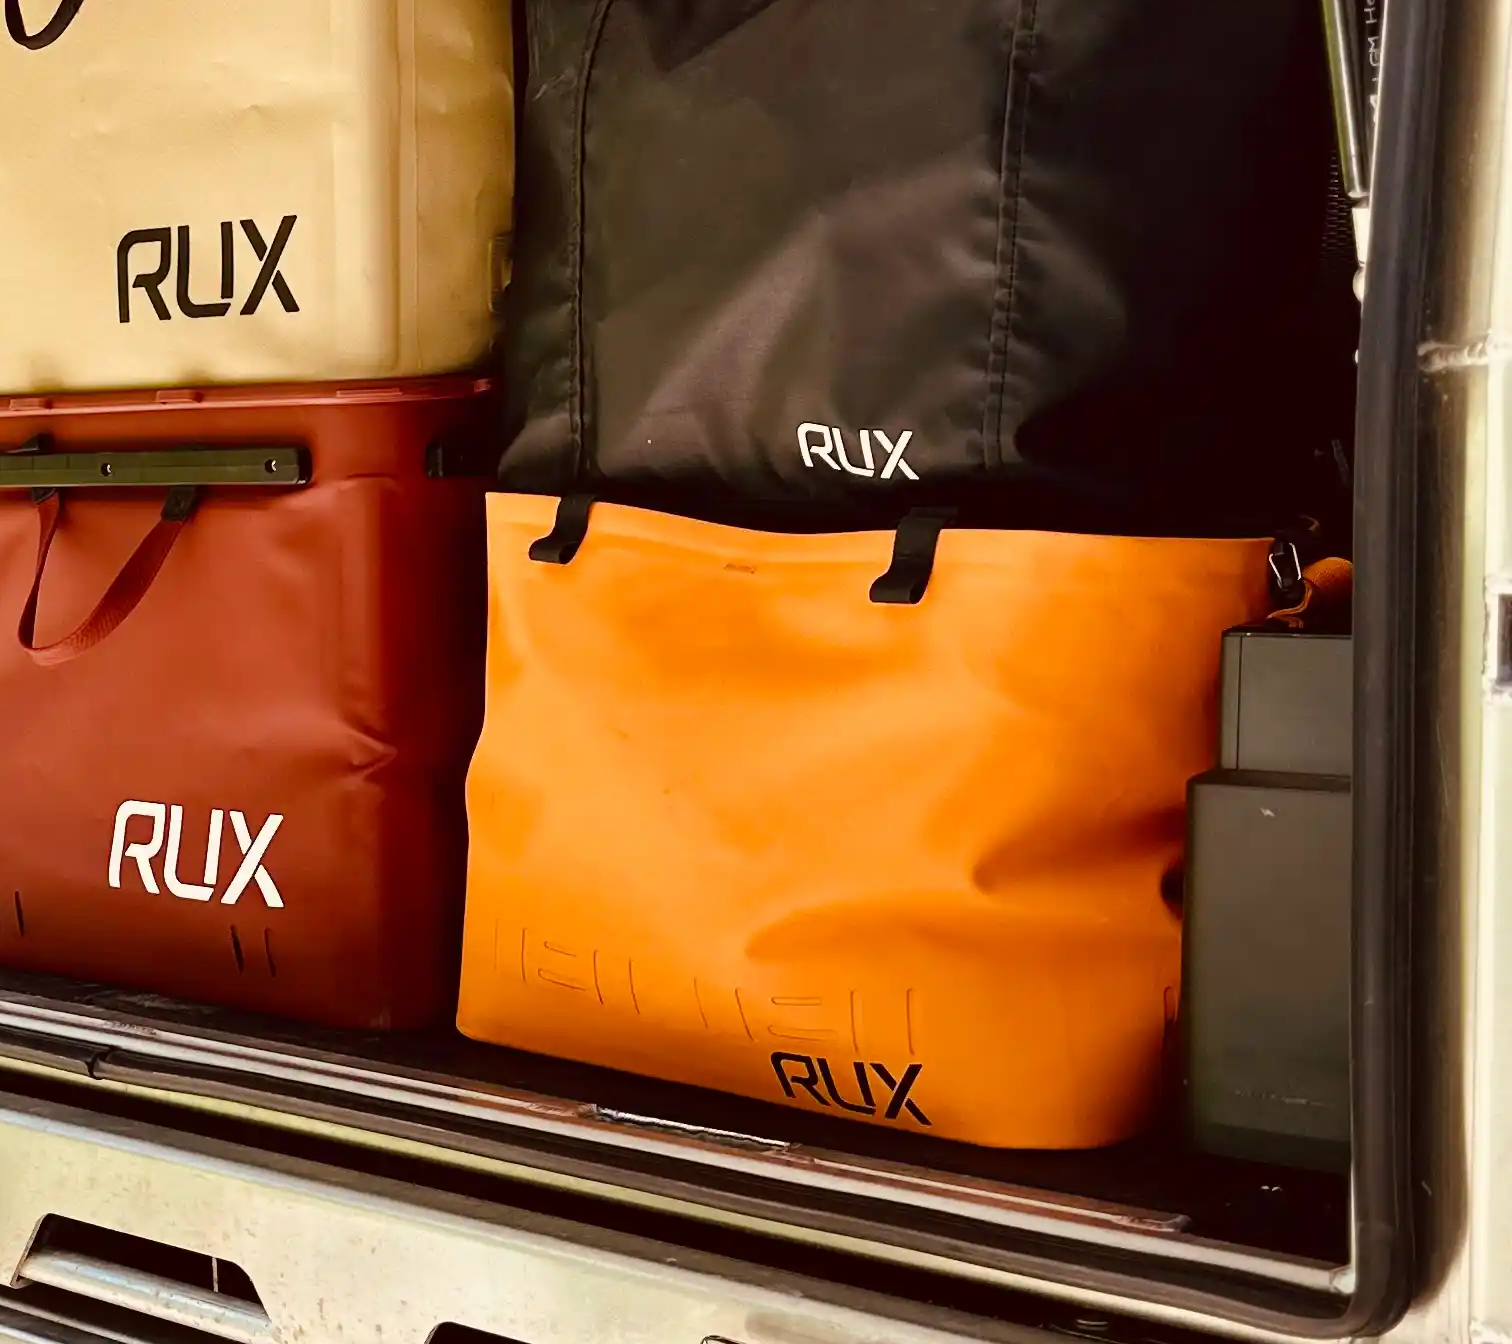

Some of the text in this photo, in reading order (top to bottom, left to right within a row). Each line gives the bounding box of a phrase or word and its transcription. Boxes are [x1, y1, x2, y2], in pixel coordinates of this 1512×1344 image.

[116, 214, 300, 324] RUX
[796, 422, 920, 481] RUX
[108, 799, 285, 908] RUX
[770, 1051, 933, 1127] RUX
